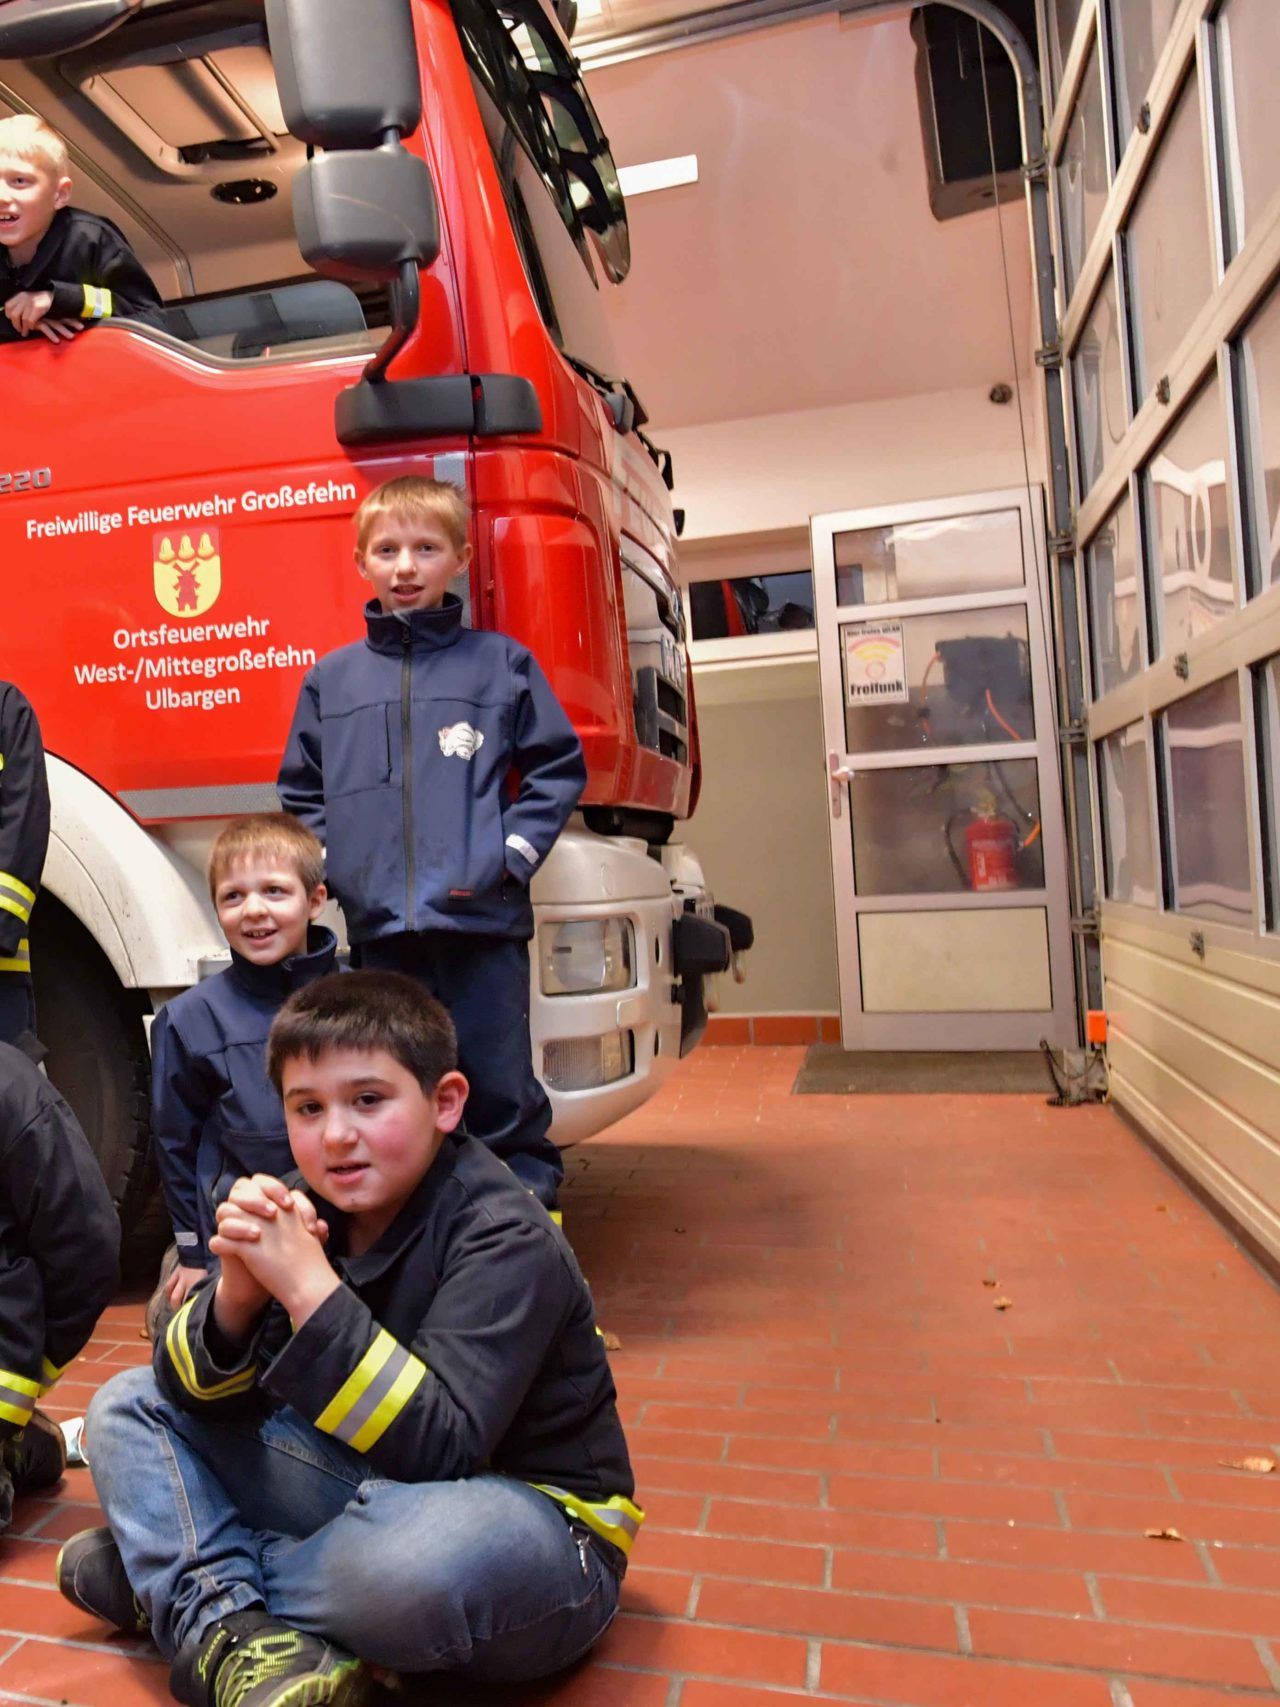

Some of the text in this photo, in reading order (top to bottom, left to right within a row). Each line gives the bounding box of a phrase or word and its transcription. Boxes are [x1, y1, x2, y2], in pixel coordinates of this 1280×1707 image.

[26, 479, 356, 540] Freiwillige Feuerwehr Großefehn
[113, 615, 270, 650] Ortsfeuerwehr
[74, 644, 316, 685] West-/Mittegroßefehn
[145, 686, 241, 711] Ulbargen
[850, 680, 903, 696] Freifunk
